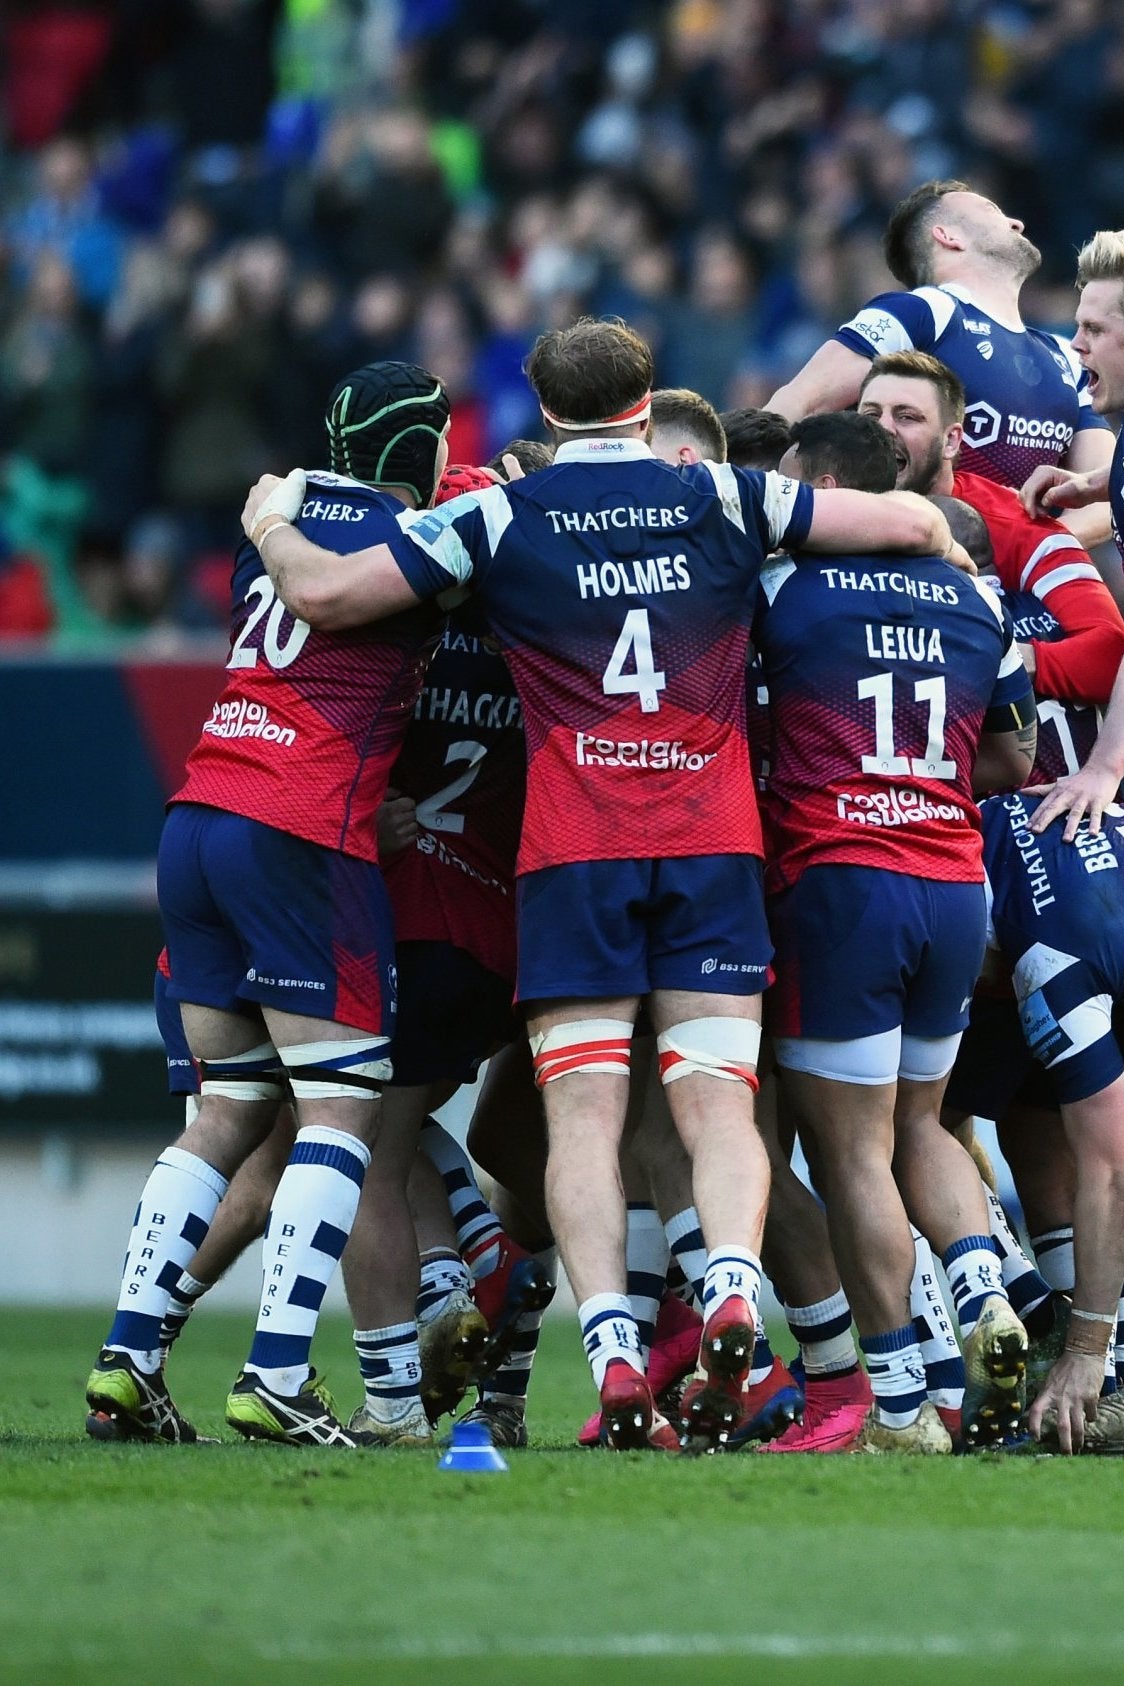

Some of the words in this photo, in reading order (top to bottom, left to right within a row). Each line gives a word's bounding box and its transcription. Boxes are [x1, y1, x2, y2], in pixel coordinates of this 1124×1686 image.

[1007, 415, 1073, 446] TOOGOO
[302, 500, 369, 521] CHERS
[546, 505, 689, 533] THATCHERS
[576, 554, 691, 600] HOLMES
[820, 568, 959, 606] THATCHERS
[225, 575, 311, 669] 20
[865, 623, 945, 664] LEIUA
[602, 608, 666, 713] 4
[857, 672, 957, 780] 11
[415, 740, 488, 834] 2
[278, 979, 326, 991] SERVICES
[126, 1212, 166, 1295] BEARS
[261, 1224, 295, 1317] BEARS
[921, 1274, 956, 1347] BEARS
